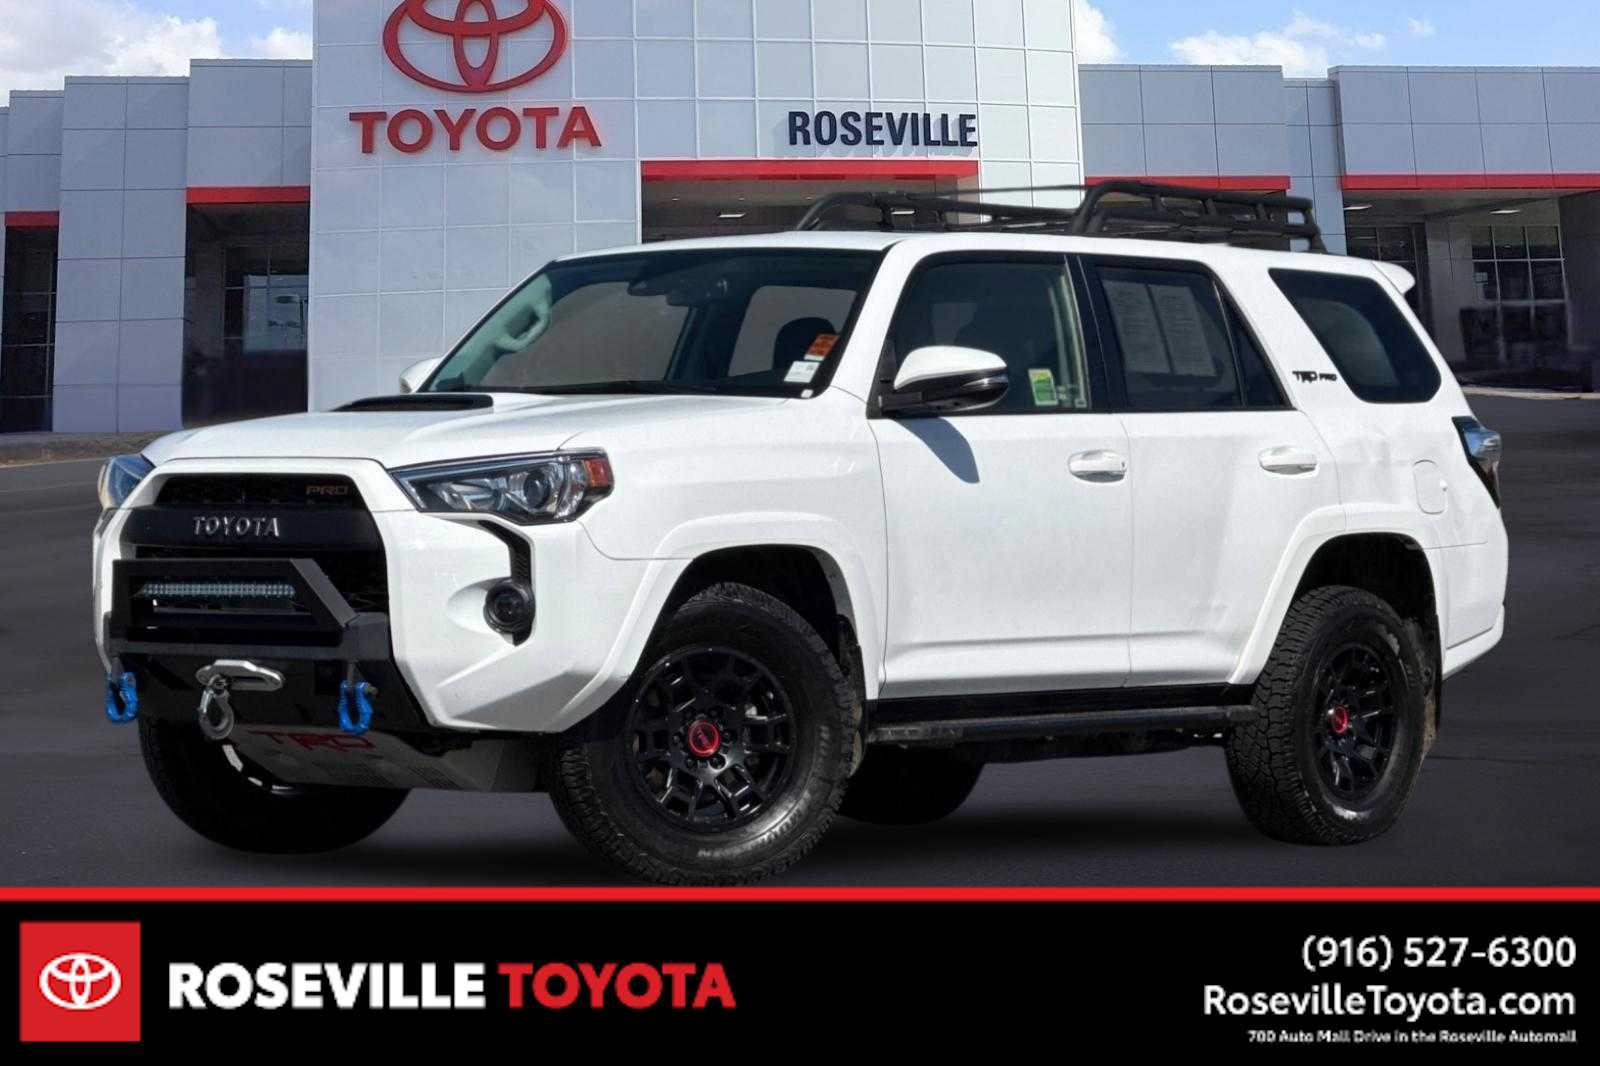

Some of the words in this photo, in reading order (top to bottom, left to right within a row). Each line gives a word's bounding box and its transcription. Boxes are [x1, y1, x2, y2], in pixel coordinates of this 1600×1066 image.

[349, 106, 602, 154] TOYOTA
[788, 110, 978, 147] ROSEVILLE
[1292, 371, 1318, 384] TRD
[305, 485, 349, 496] PRO
[193, 516, 280, 537] TOYOTA
[247, 730, 376, 752] TRD
